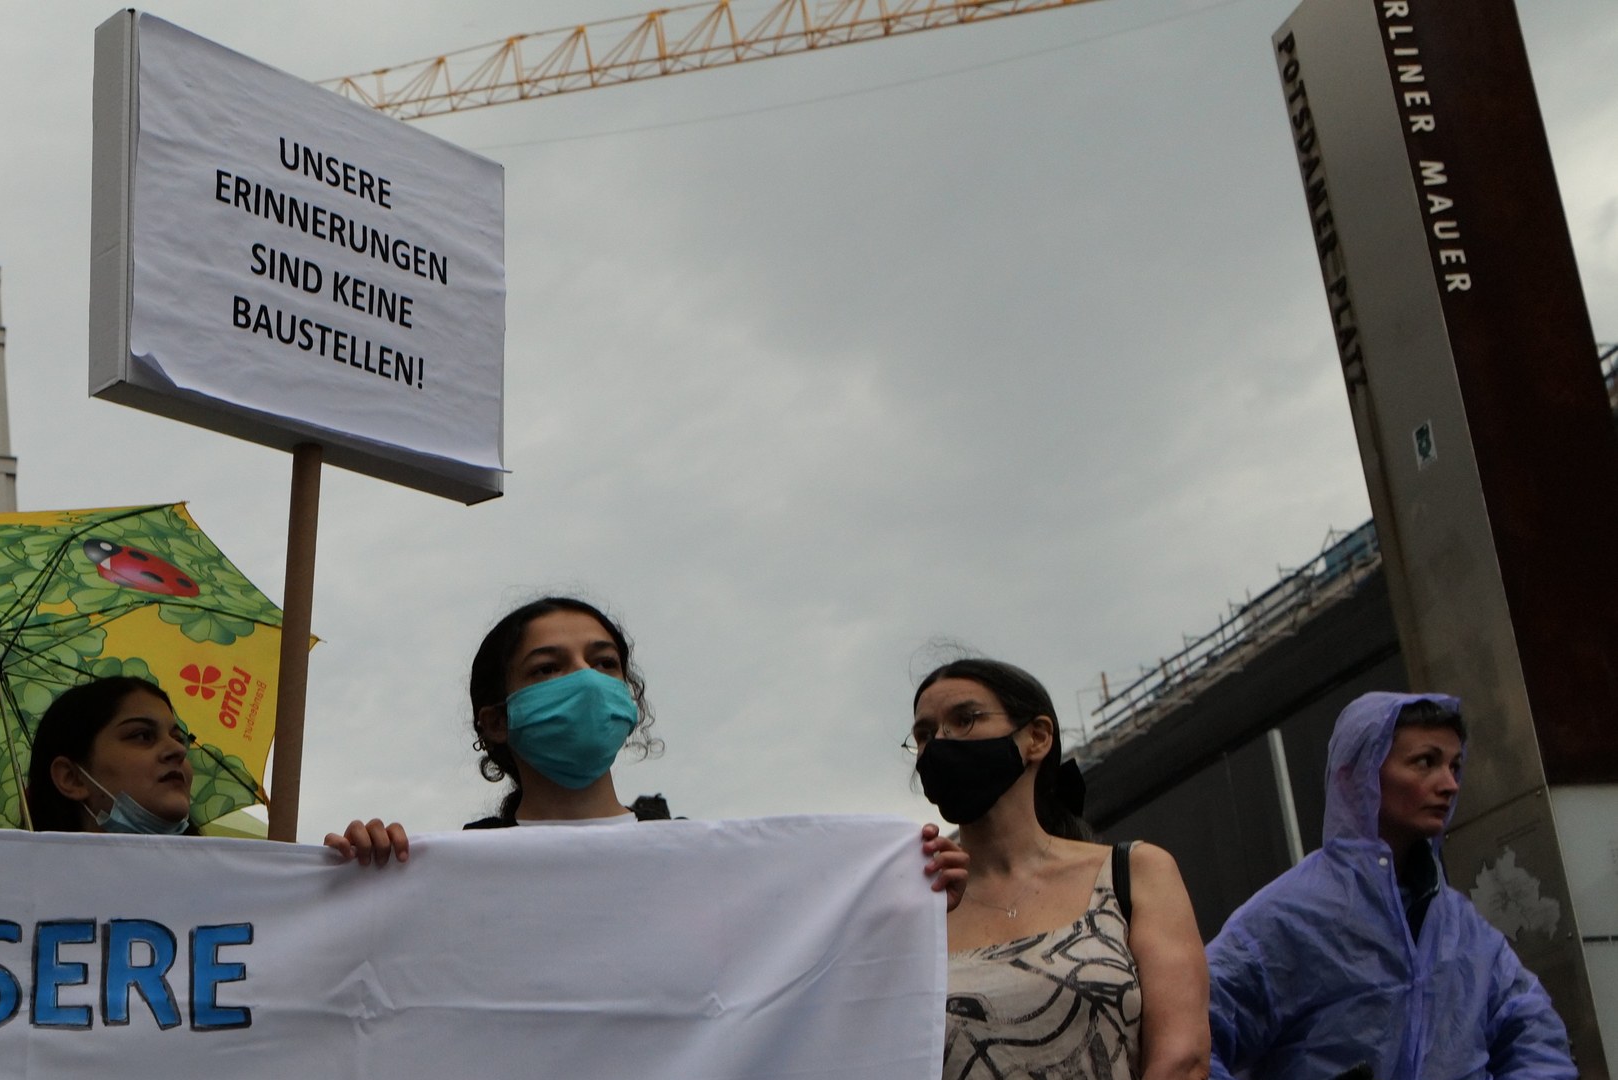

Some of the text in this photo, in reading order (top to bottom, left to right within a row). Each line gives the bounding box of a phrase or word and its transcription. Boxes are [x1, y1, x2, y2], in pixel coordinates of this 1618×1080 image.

[279, 137, 392, 210] UNSERE
[1383, 1, 1472, 293] RLINER MAUER
[215, 169, 448, 286] ERINNERUNGEN
[1278, 31, 1368, 395] POTSDAMER PLATZ
[250, 243, 413, 329] SIND KEINE
[232, 295, 424, 390] BAUSTELLEN!
